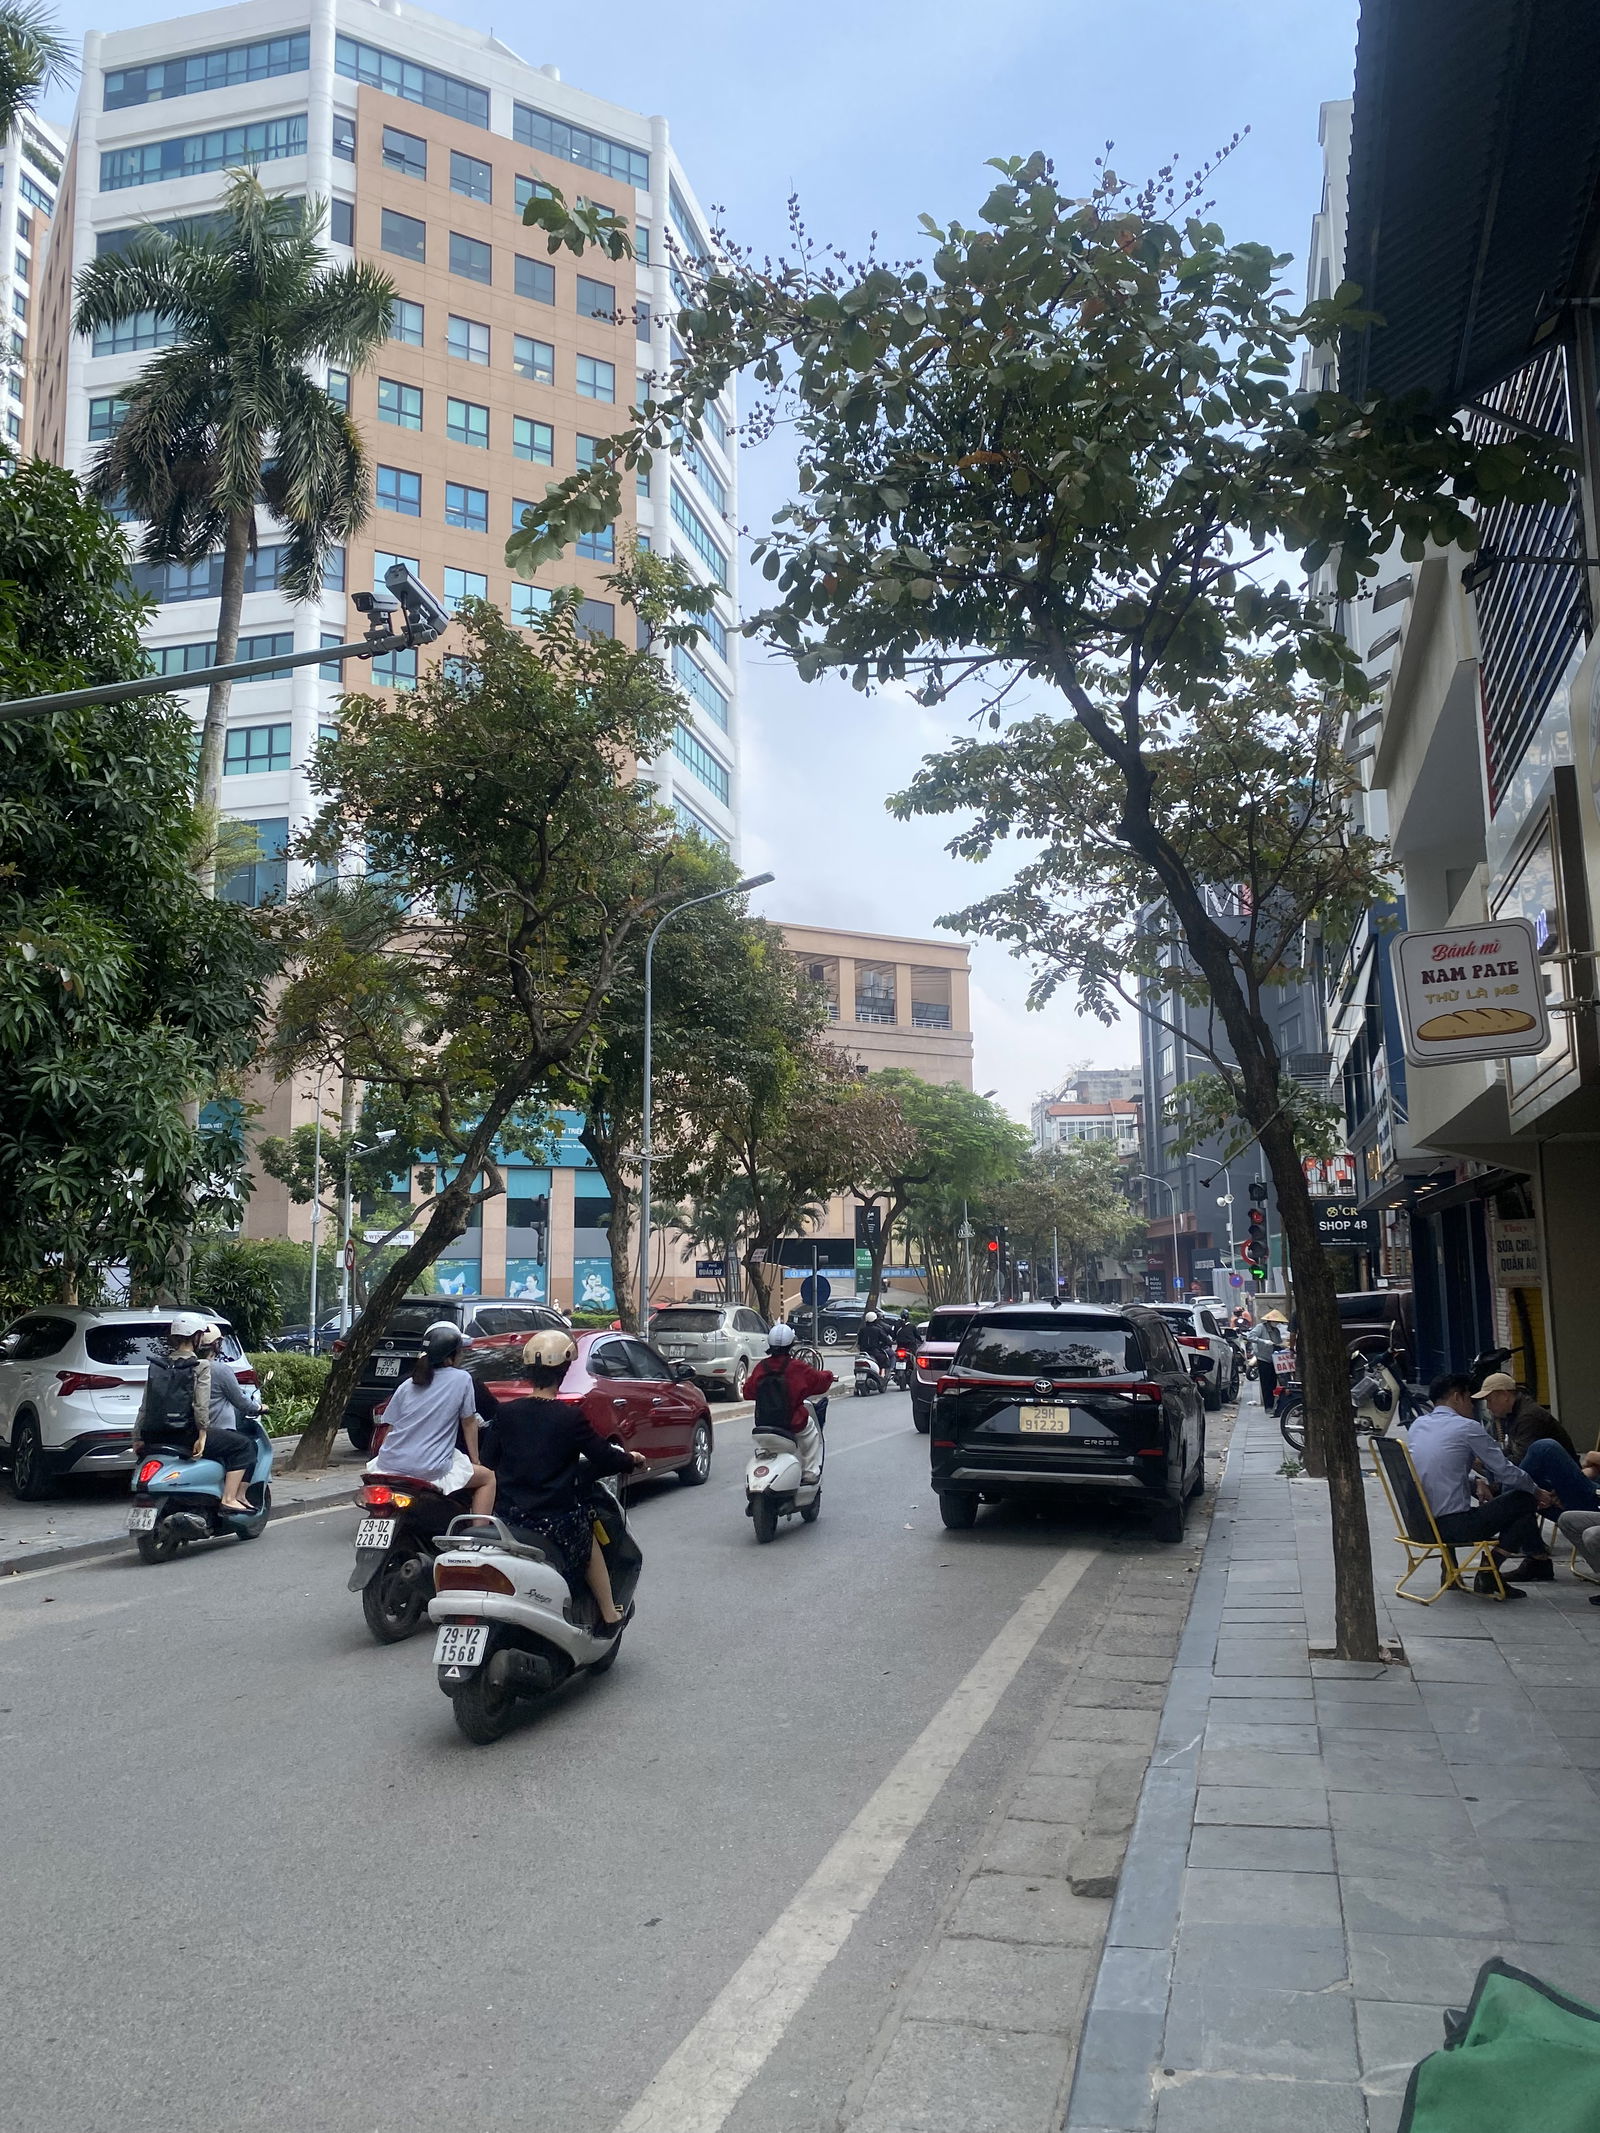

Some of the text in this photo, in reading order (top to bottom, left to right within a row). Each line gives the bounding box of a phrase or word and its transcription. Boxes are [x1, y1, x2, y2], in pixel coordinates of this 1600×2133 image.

[1432, 941, 1476, 961] Bánh
[1421, 961, 1519, 985] NAM PATE
[1319, 1220, 1368, 1231] SHOP 48
[1034, 1408, 1056, 1419] 29H
[1025, 1420, 1064, 1431] 912.23
[442, 1627, 481, 1645] 29-V2
[440, 1645, 476, 1662] 1568
